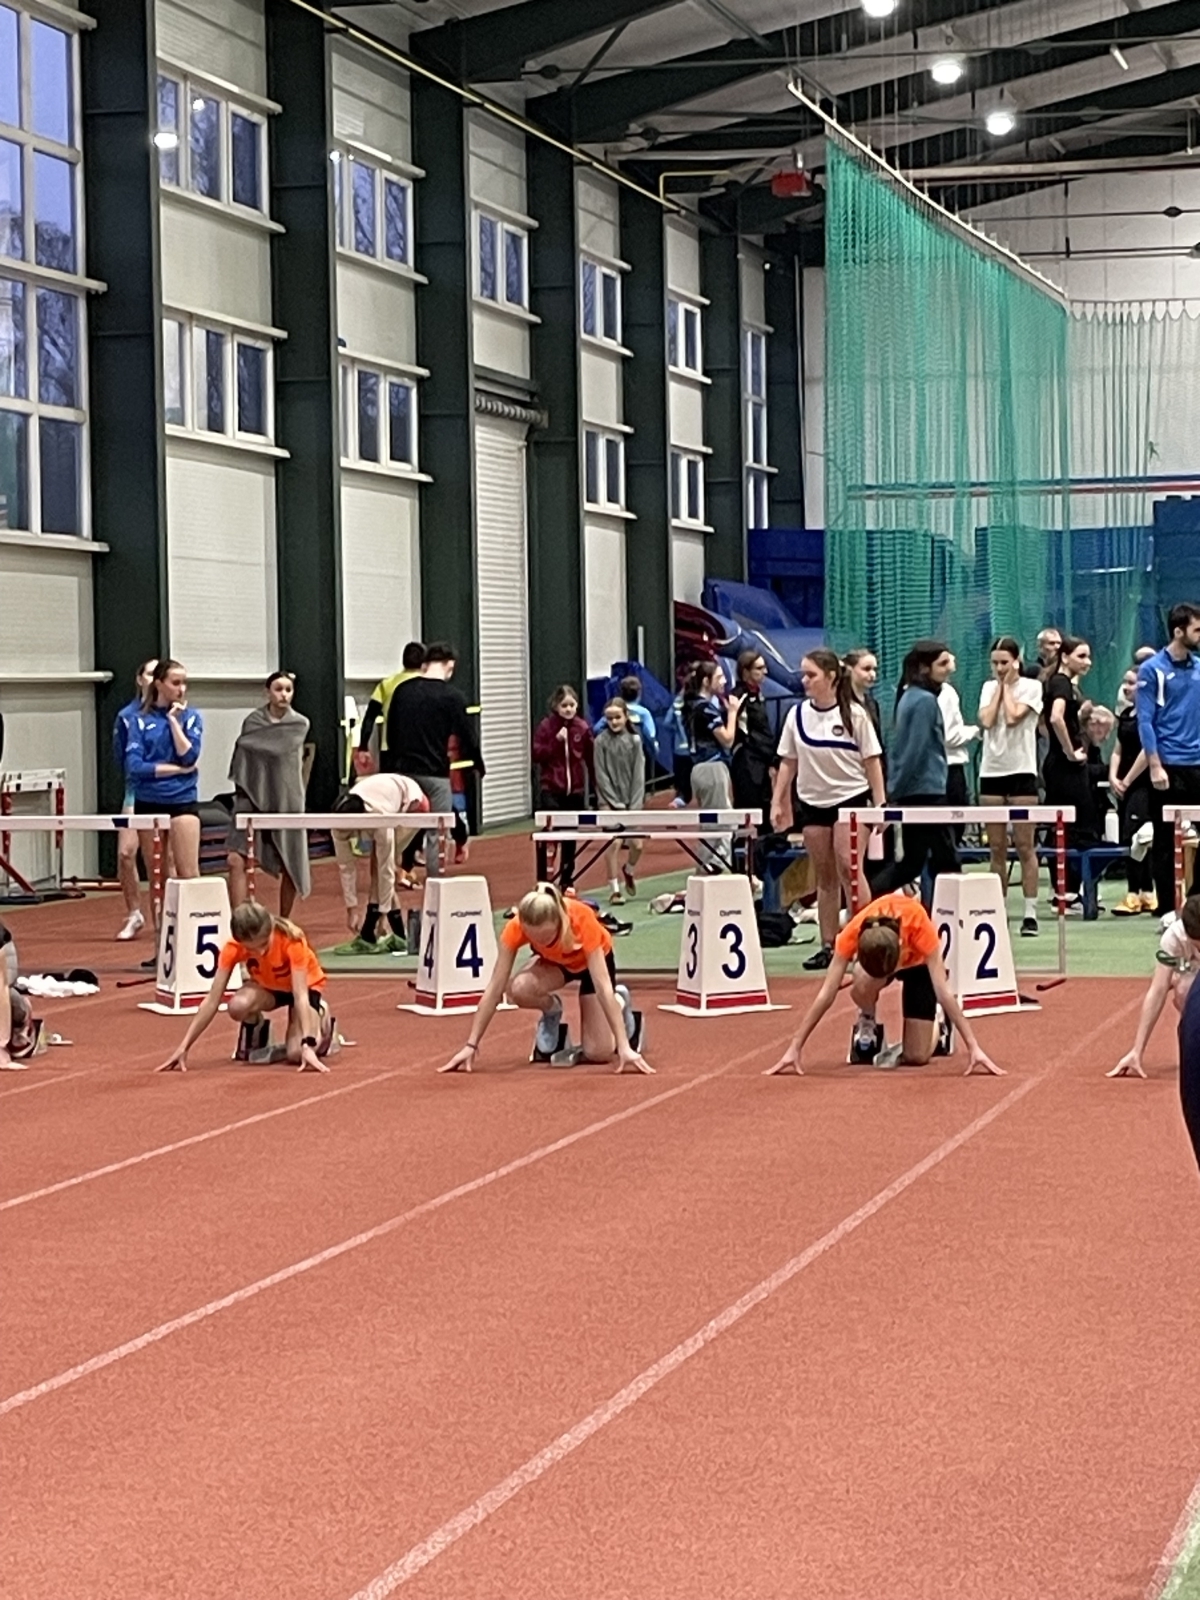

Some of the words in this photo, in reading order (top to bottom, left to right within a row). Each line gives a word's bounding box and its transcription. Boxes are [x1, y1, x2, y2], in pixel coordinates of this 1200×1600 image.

[163, 925, 175, 979] 5
[196, 925, 221, 979] 5
[424, 923, 435, 979] 4
[456, 923, 483, 978] 4
[686, 923, 698, 979] 3
[719, 923, 746, 979] 3
[974, 922, 998, 979] 2
